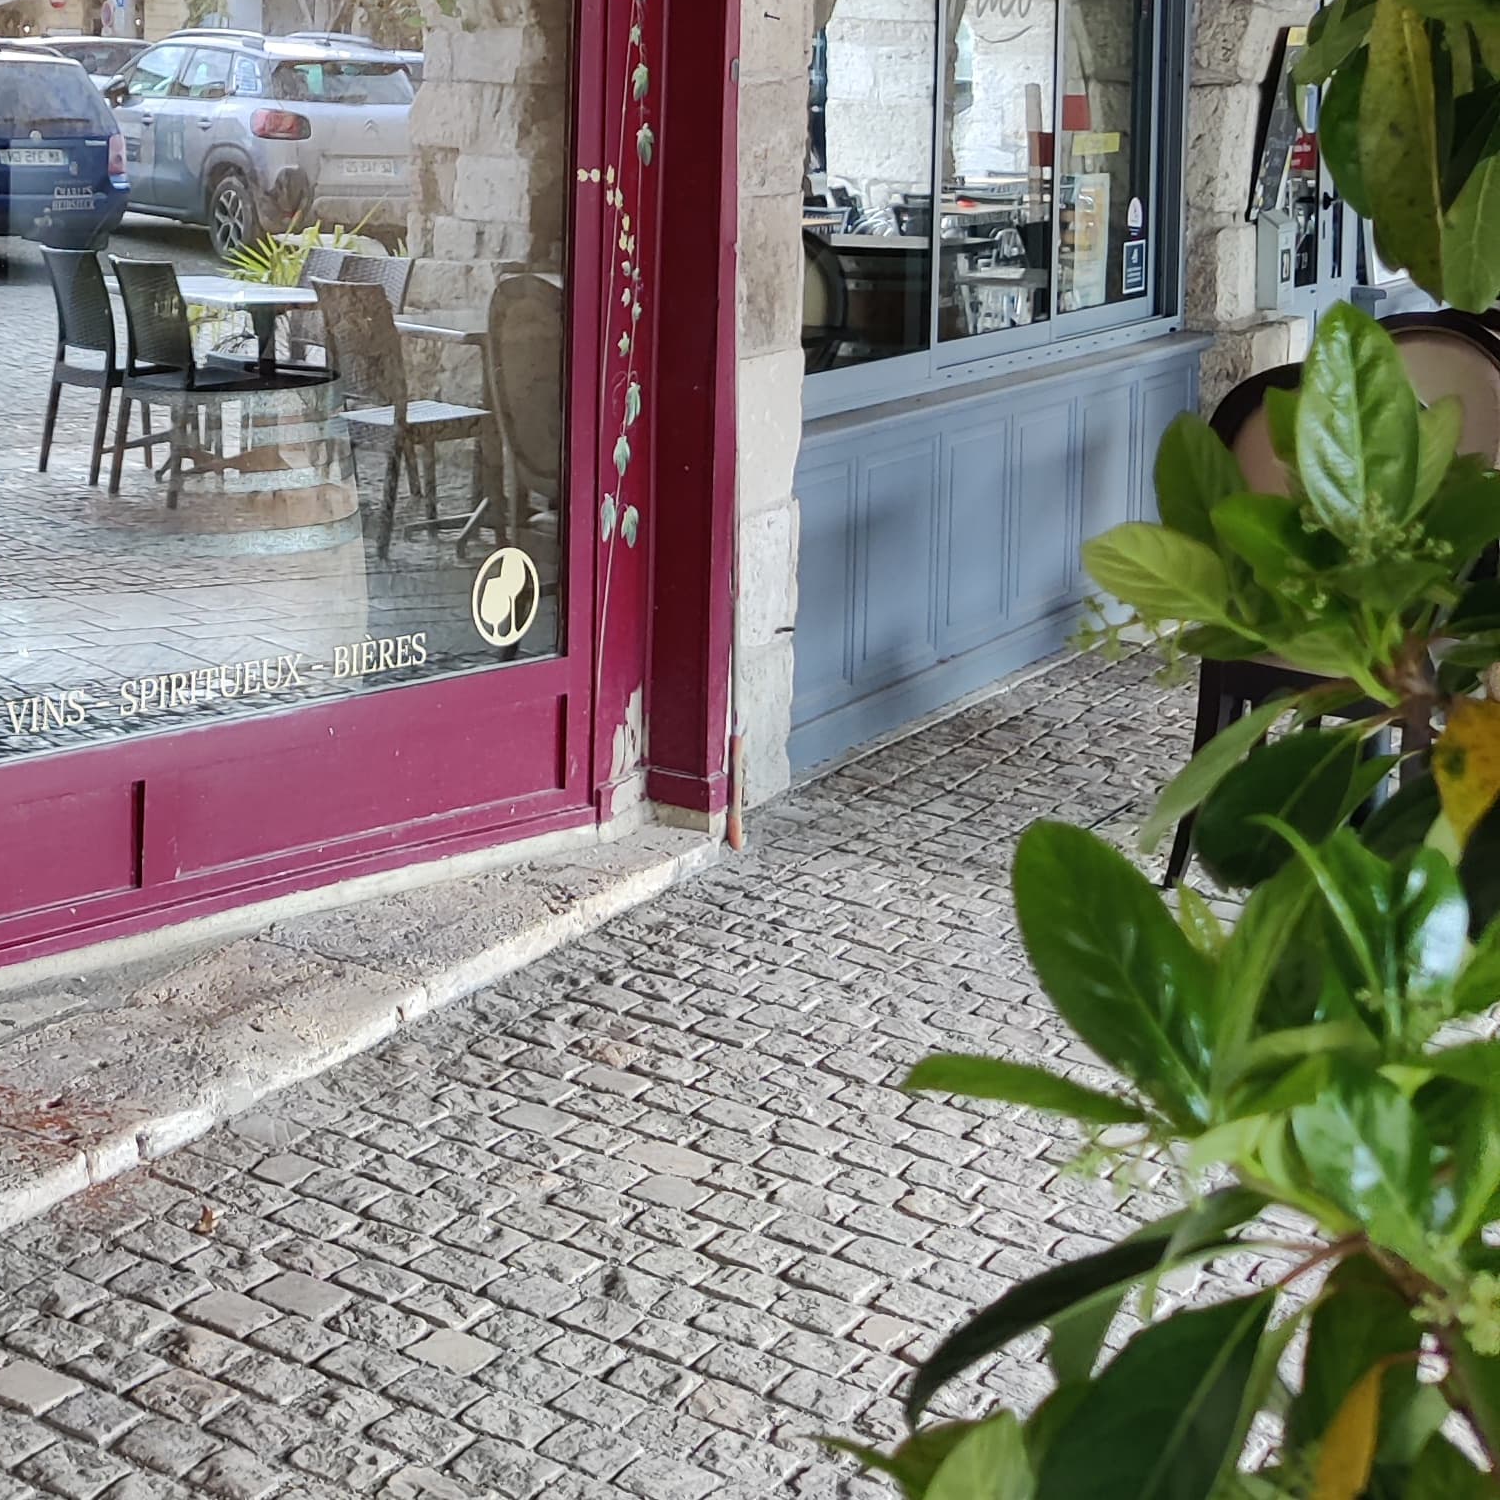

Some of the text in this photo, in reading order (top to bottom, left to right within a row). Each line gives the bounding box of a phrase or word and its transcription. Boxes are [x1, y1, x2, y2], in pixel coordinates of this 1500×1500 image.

[6, 688, 86, 735] VINS
[119, 652, 304, 717] SPIRITUEUX
[332, 631, 428, 679] BIÈRES
